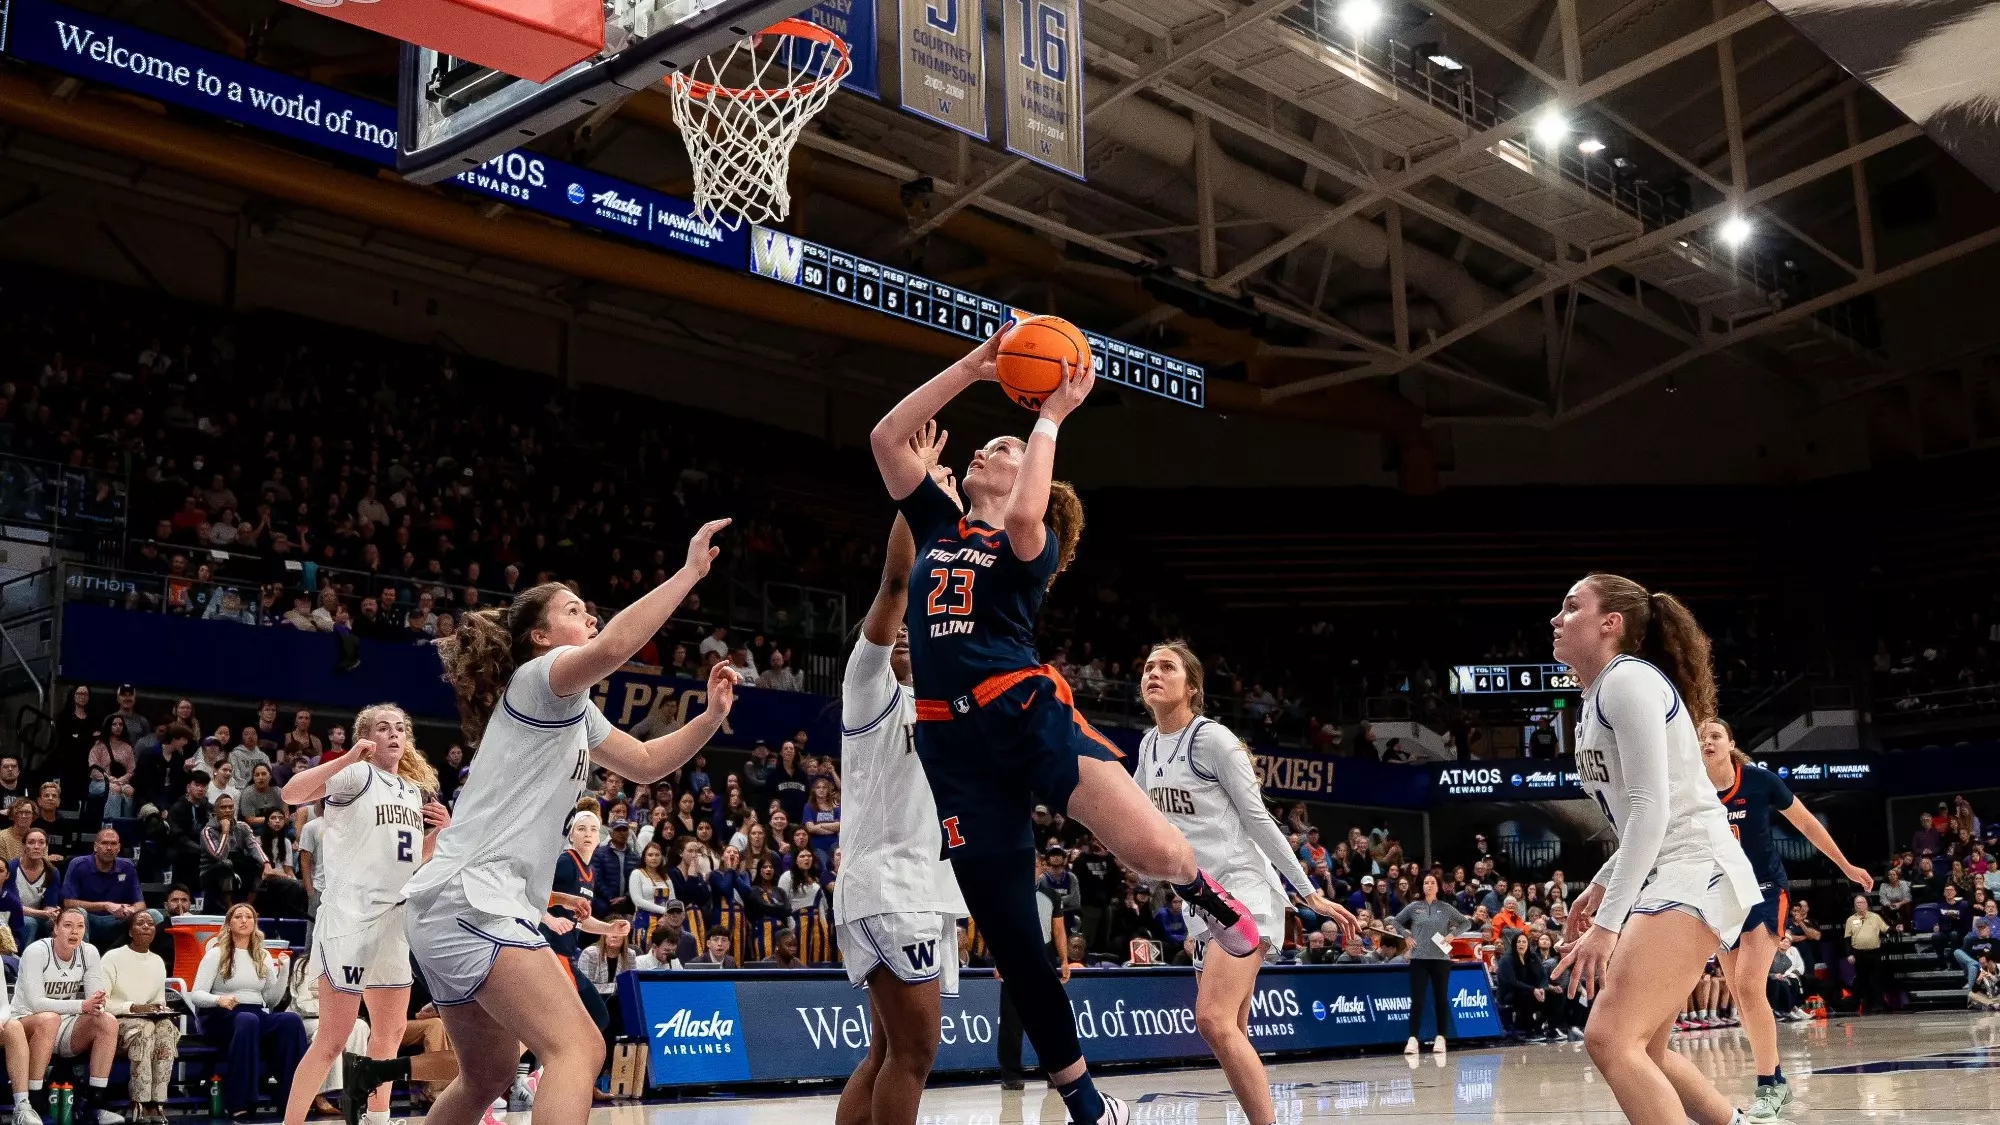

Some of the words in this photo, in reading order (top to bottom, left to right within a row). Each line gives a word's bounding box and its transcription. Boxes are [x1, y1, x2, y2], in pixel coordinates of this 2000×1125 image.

[811, 7, 847, 35] PLUM
[913, 28, 972, 64] COURTNEY
[1017, 0, 1067, 84] 16
[55, 20, 190, 86] Welcome
[196, 68, 222, 96] to
[227, 82, 242, 102] a
[249, 87, 321, 126] world
[325, 109, 353, 134] of
[911, 47, 976, 86] THOMPSON
[1025, 77, 1063, 105] KRISTA
[592, 190, 643, 217] Alaska
[657, 210, 723, 242] HAWAIIAN
[803, 244, 827, 259] FG%
[883, 270, 904, 283] REB
[908, 278, 928, 290] AST
[935, 286, 950, 298] TO
[956, 293, 976, 306] BLK
[981, 301, 999, 314] STL
[804, 266, 823, 285] 50
[836, 276, 847, 293] 0
[863, 283, 873, 300] 0
[887, 291, 897, 308] 5
[915, 300, 923, 316] 1
[938, 307, 947, 324] 2
[961, 314, 971, 330] 0
[984, 322, 993, 337] 0
[1108, 342, 1126, 354] REB
[1128, 349, 1144, 360] AST
[1150, 356, 1162, 366] TO
[1167, 362, 1183, 373] BLK
[1186, 370, 1201, 379] STL
[1112, 361, 1120, 376] 3
[1134, 368, 1141, 383] 1
[1151, 373, 1160, 388] 0
[1170, 380, 1178, 394] 0
[1191, 385, 1197, 400] 1
[925, 548, 997, 568] FIGTING
[927, 568, 975, 616] 23
[930, 620, 975, 638] ILLINI
[1479, 676, 1487, 688] 4
[1496, 676, 1504, 688] 0
[1521, 671, 1531, 686] 6
[1439, 768, 1502, 785] ATMOS
[1526, 772, 1557, 782] Alaska
[1791, 764, 1821, 775] Alaska
[1829, 765, 1870, 774] HAWAIIAN
[1149, 786, 1195, 815] SKIES
[1449, 785, 1494, 794] REWARDS
[942, 816, 966, 848] I
[397, 829, 414, 863] 2
[901, 938, 936, 971] W
[342, 965, 365, 985] W
[1250, 988, 1300, 1018] MOS
[1329, 995, 1365, 1014] Alaska
[1451, 988, 1488, 1009] Alaska
[655, 1008, 734, 1041] Alaska
[796, 1004, 957, 1050] Wele
[960, 1009, 992, 1043] to
[1101, 1000, 1125, 1038] of
[1130, 1007, 1197, 1037] more
[1336, 1015, 1367, 1024] AIRLINES
[1387, 1013, 1411, 1021] AIRLIN
[1458, 1011, 1489, 1019] AIRLINES
[1247, 1023, 1295, 1038] EWARDS
[664, 1043, 732, 1056] AIRLINES
[49, 1094, 58, 1104] G
[210, 1086, 219, 1096] G
